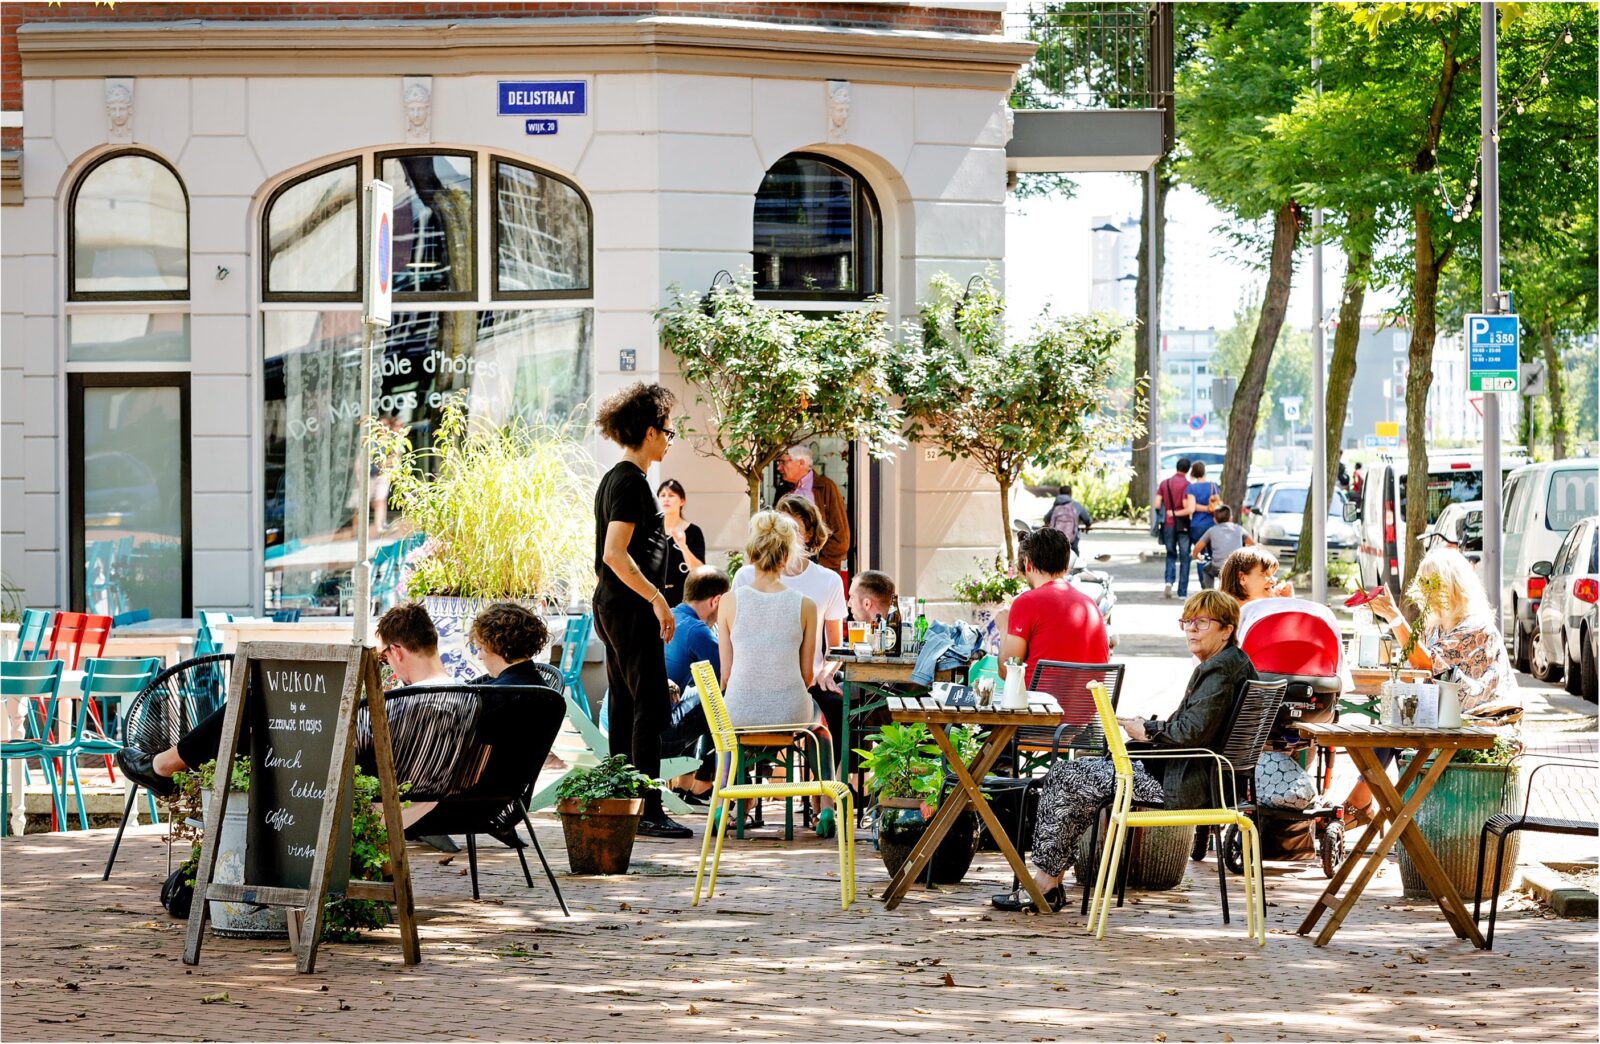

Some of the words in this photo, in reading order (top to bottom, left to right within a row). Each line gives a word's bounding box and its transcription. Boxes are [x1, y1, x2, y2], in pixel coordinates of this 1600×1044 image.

[508, 91, 575, 105] DELISTRAAT
[547, 123, 555, 131] 20
[1472, 319, 1489, 343] P
[1496, 334, 1514, 343] 350
[371, 353, 412, 376] able
[287, 416, 320, 440] De
[329, 391, 418, 424] Maroos
[927, 451, 935, 459] 52
[300, 703, 306, 711] de
[264, 747, 302, 768] lunch
[265, 808, 295, 831] coffee
[287, 844, 316, 858] vinta
